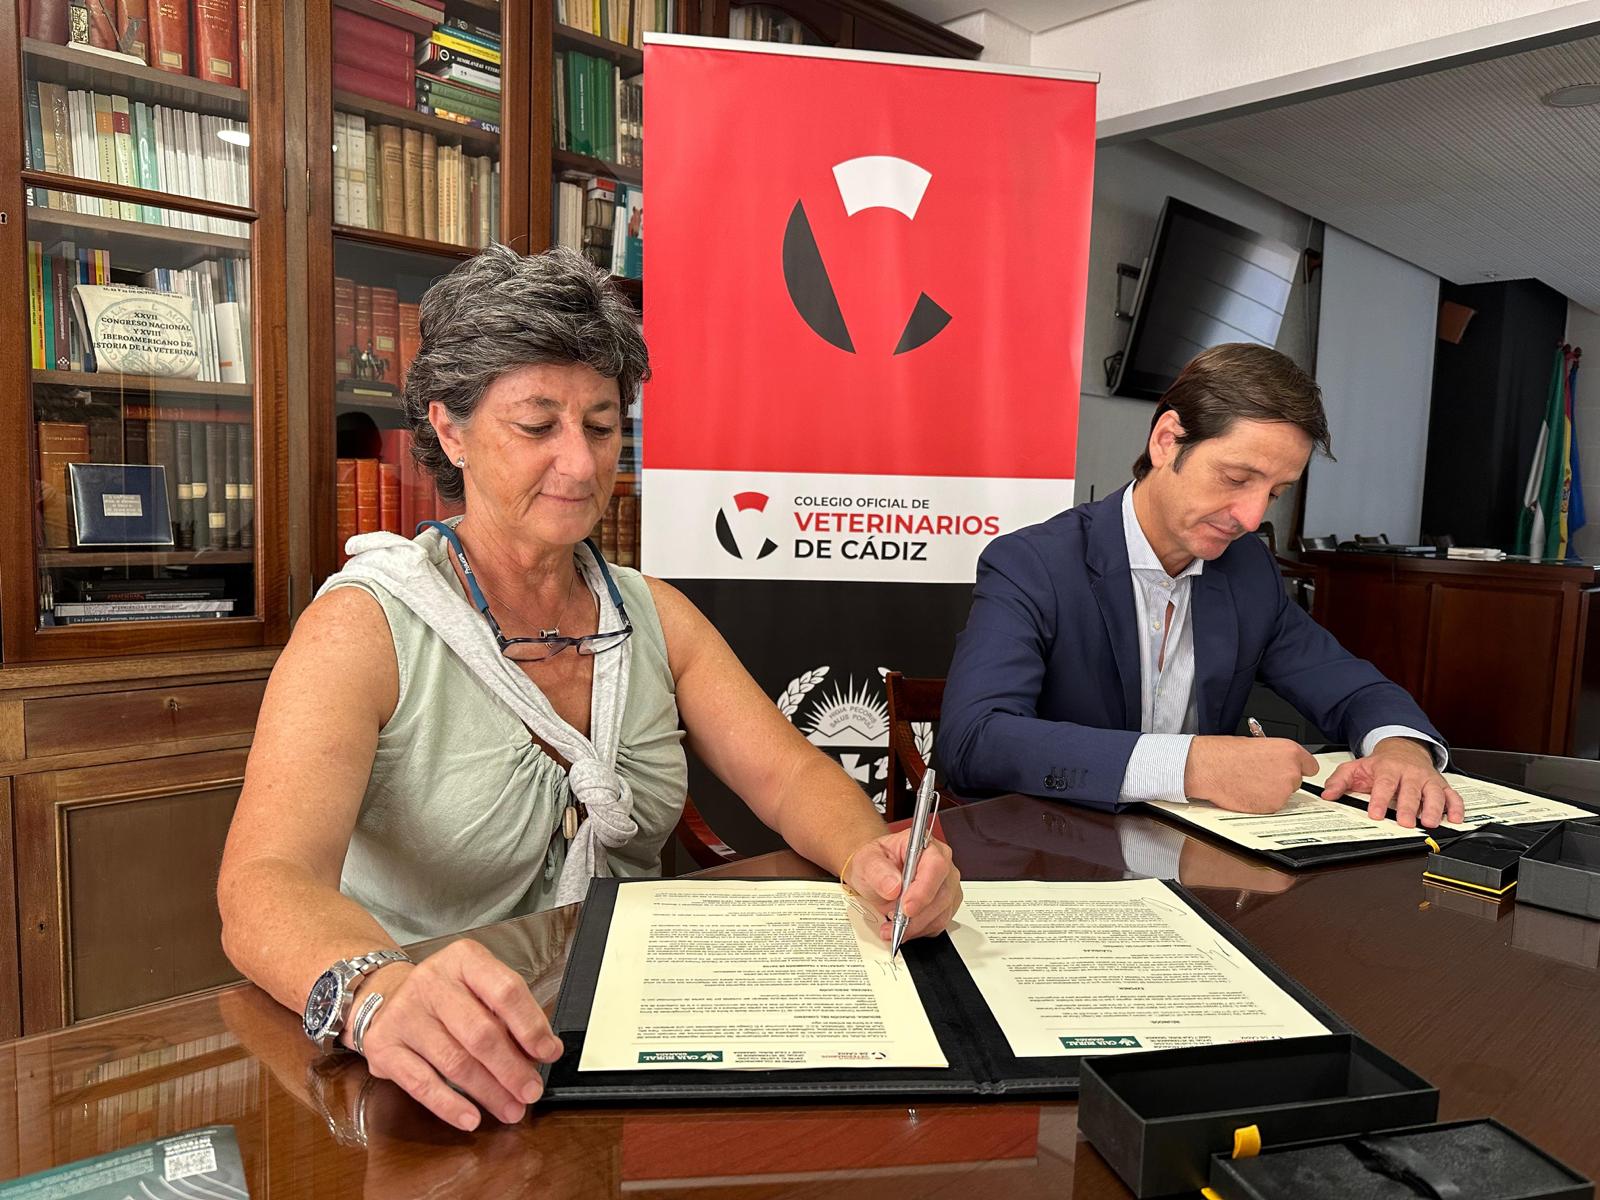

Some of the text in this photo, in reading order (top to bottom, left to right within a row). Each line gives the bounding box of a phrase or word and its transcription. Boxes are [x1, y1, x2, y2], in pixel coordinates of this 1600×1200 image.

[134, 312, 158, 321] XXVII
[101, 317, 191, 331] CONGRESO NACIONAL
[140, 329, 162, 337] XVIII
[94, 342, 127, 350] ISTORIA
[129, 344, 141, 352] DE
[103, 334, 193, 348] IBEROAMERICANO DE
[794, 496, 930, 509] COLEGIO OFICIAL DE
[793, 512, 1000, 536] VETERINARIOS
[794, 535, 928, 561] DE CÁDIZ
